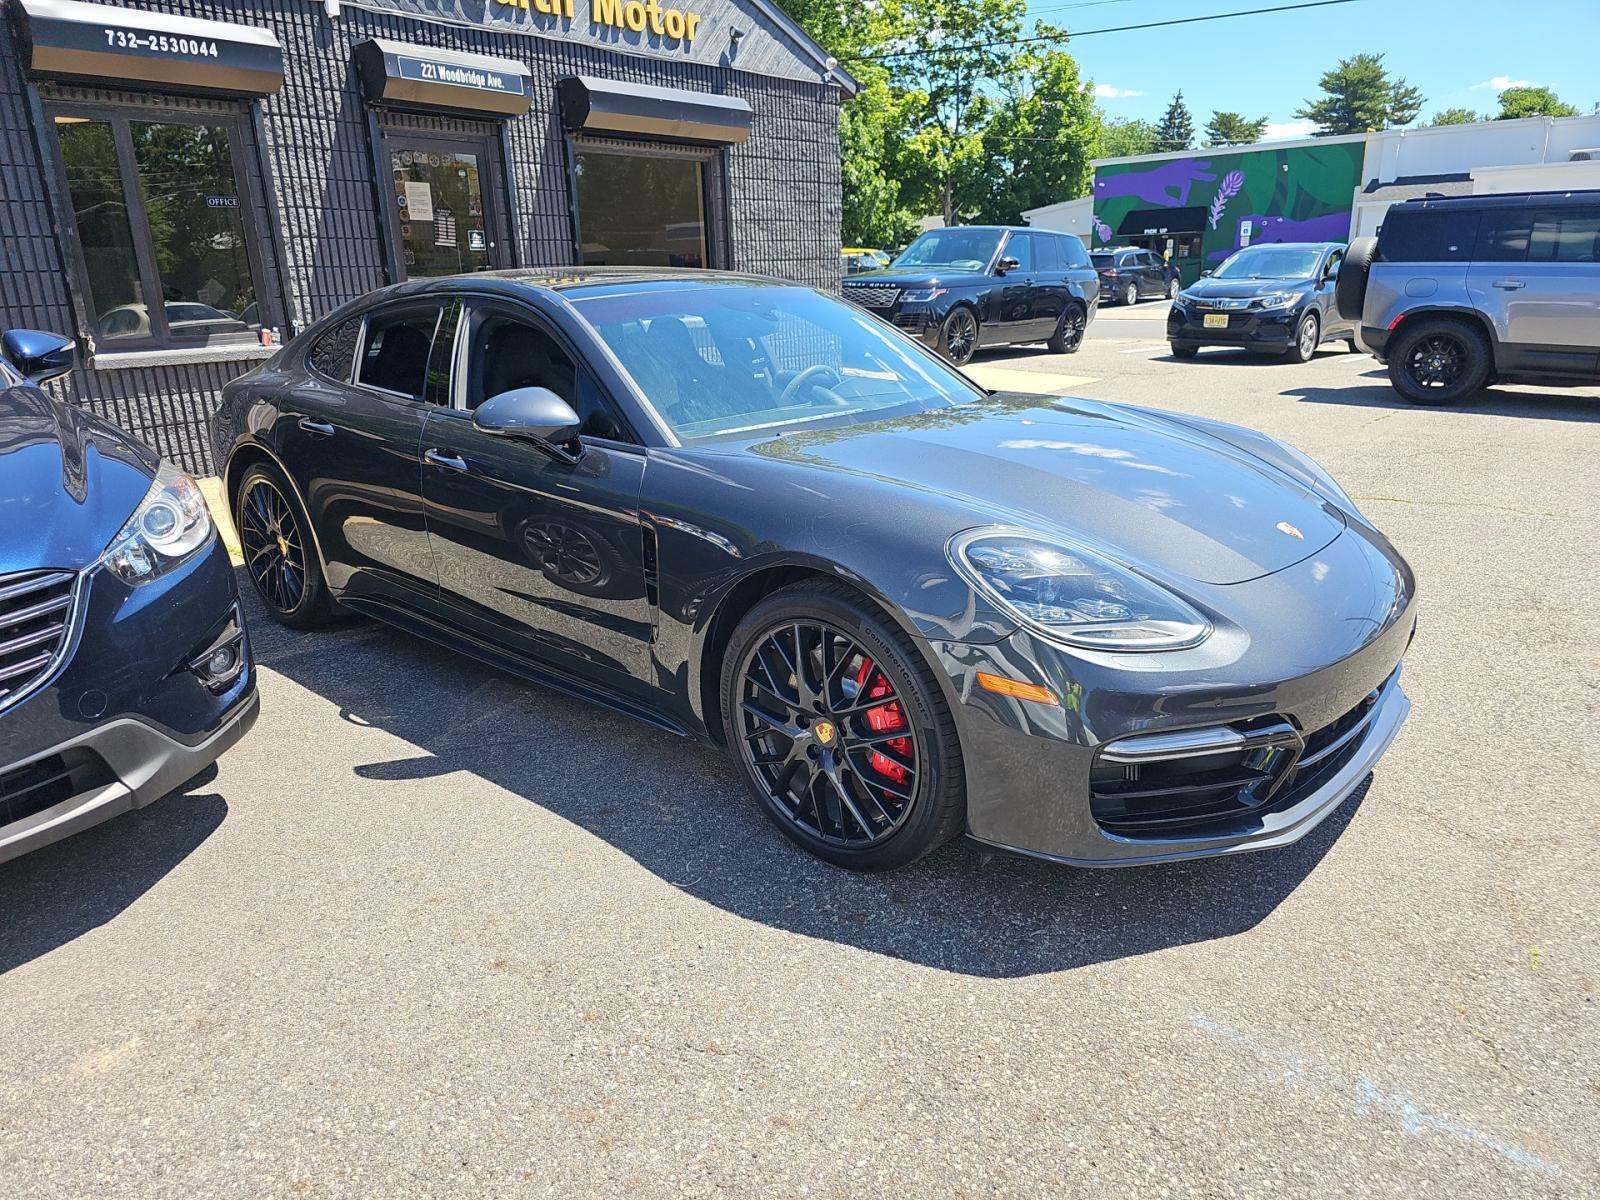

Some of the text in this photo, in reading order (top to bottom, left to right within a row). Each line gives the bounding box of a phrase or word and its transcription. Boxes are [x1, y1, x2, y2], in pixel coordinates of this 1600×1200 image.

[589, 0, 700, 41] Motor
[104, 29, 218, 58] 732-2530044
[420, 63, 505, 89] 221 Woodbridge Ave.
[208, 198, 239, 206] OFFICE
